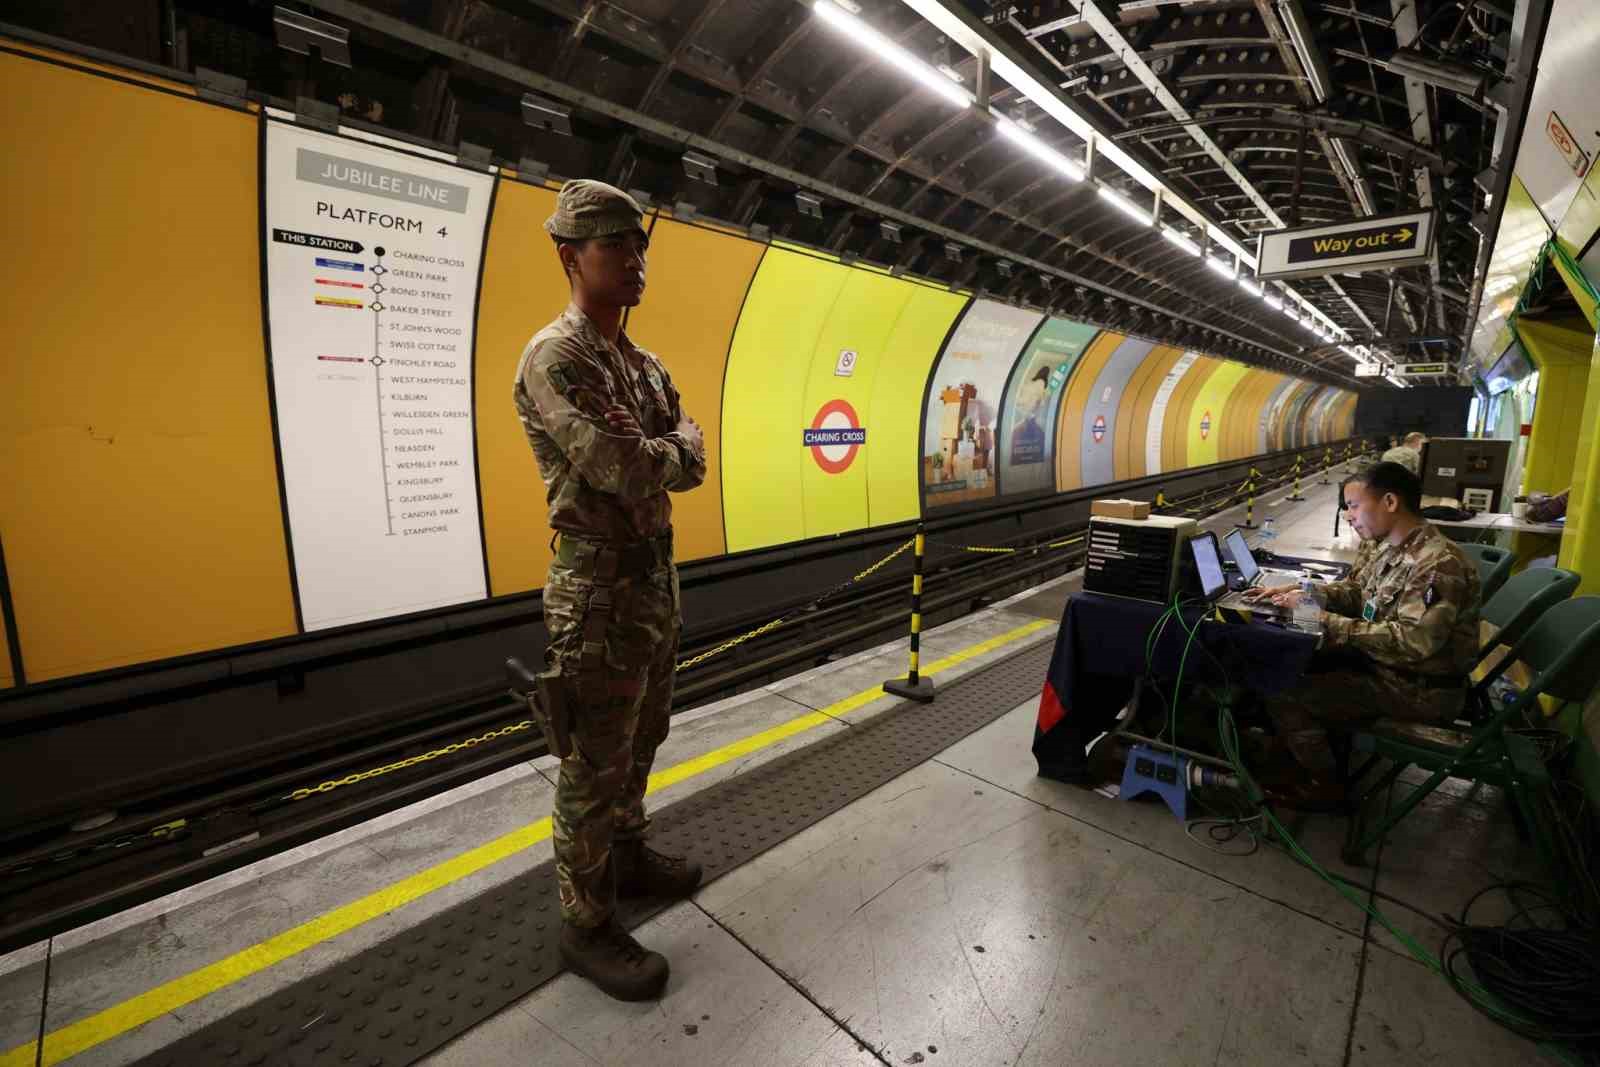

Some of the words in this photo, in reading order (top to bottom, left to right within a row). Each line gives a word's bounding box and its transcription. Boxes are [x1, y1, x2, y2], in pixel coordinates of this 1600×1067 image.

[320, 162, 404, 193] JUBILEE
[407, 181, 449, 203] LINE
[316, 201, 423, 234] PLATFORM
[437, 226, 448, 238] 4
[281, 231, 306, 244] THIS
[310, 236, 354, 251] STATION
[1313, 238, 1353, 254] Way
[1355, 232, 1390, 248] out
[393, 250, 436, 263] CHARING
[437, 257, 465, 267] CROSS
[392, 268, 423, 279] GREEN
[425, 273, 448, 281] PARK
[390, 286, 418, 296] BOND
[421, 290, 453, 300] STREET
[390, 304, 419, 314] BAKER
[421, 307, 453, 317] STREET
[434, 327, 462, 335] WOOD
[389, 341, 416, 349] SWISS
[417, 343, 456, 352] COTTAGE
[389, 358, 431, 368] FINCHLEY
[433, 360, 456, 368] ROAD
[391, 376, 415, 384] WEST
[415, 377, 466, 385] HAMPSTEAD
[391, 393, 428, 401] KILBURN
[392, 410, 440, 418] WILLESDEN
[442, 410, 469, 418] GREEN
[805, 432, 840, 443] CHARING
[842, 431, 865, 442] CROSS
[394, 444, 435, 453] NEASDEN
[397, 460, 437, 469] WEMBLEY
[397, 477, 443, 486] KINGSBURY
[401, 510, 437, 519] CANONS
[402, 524, 449, 536] STANMORE
